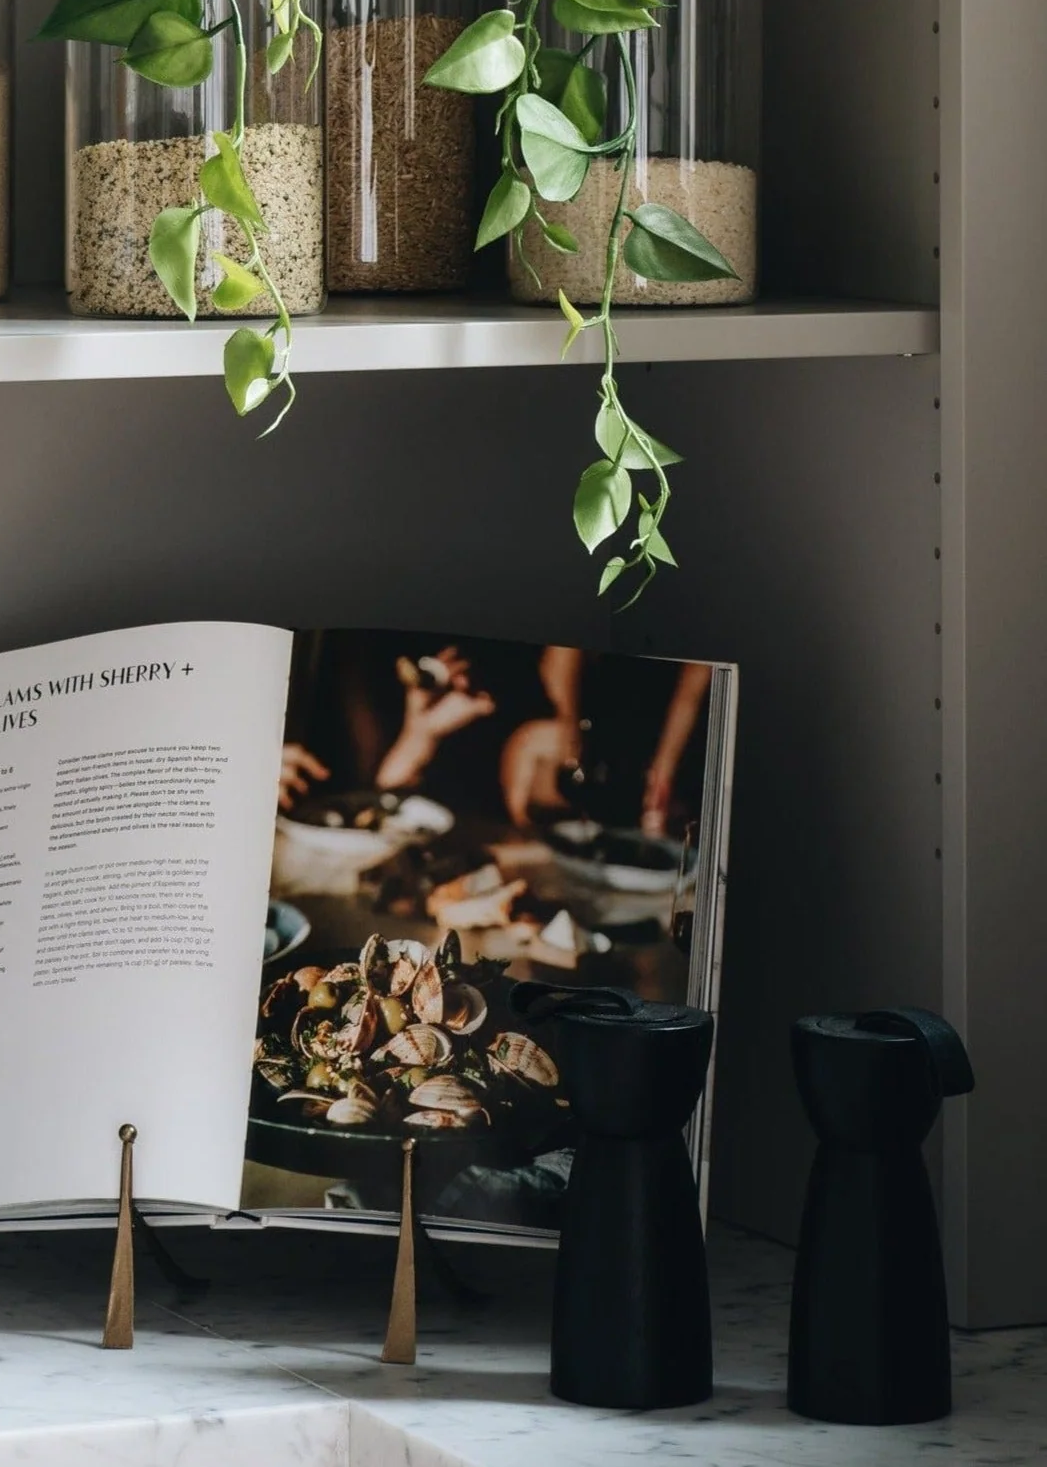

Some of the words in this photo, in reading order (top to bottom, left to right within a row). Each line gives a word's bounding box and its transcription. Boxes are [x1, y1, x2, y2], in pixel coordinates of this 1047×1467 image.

[48, 672, 94, 697] WITH
[99, 661, 177, 688] SHERRY
[181, 663, 194, 678] +
